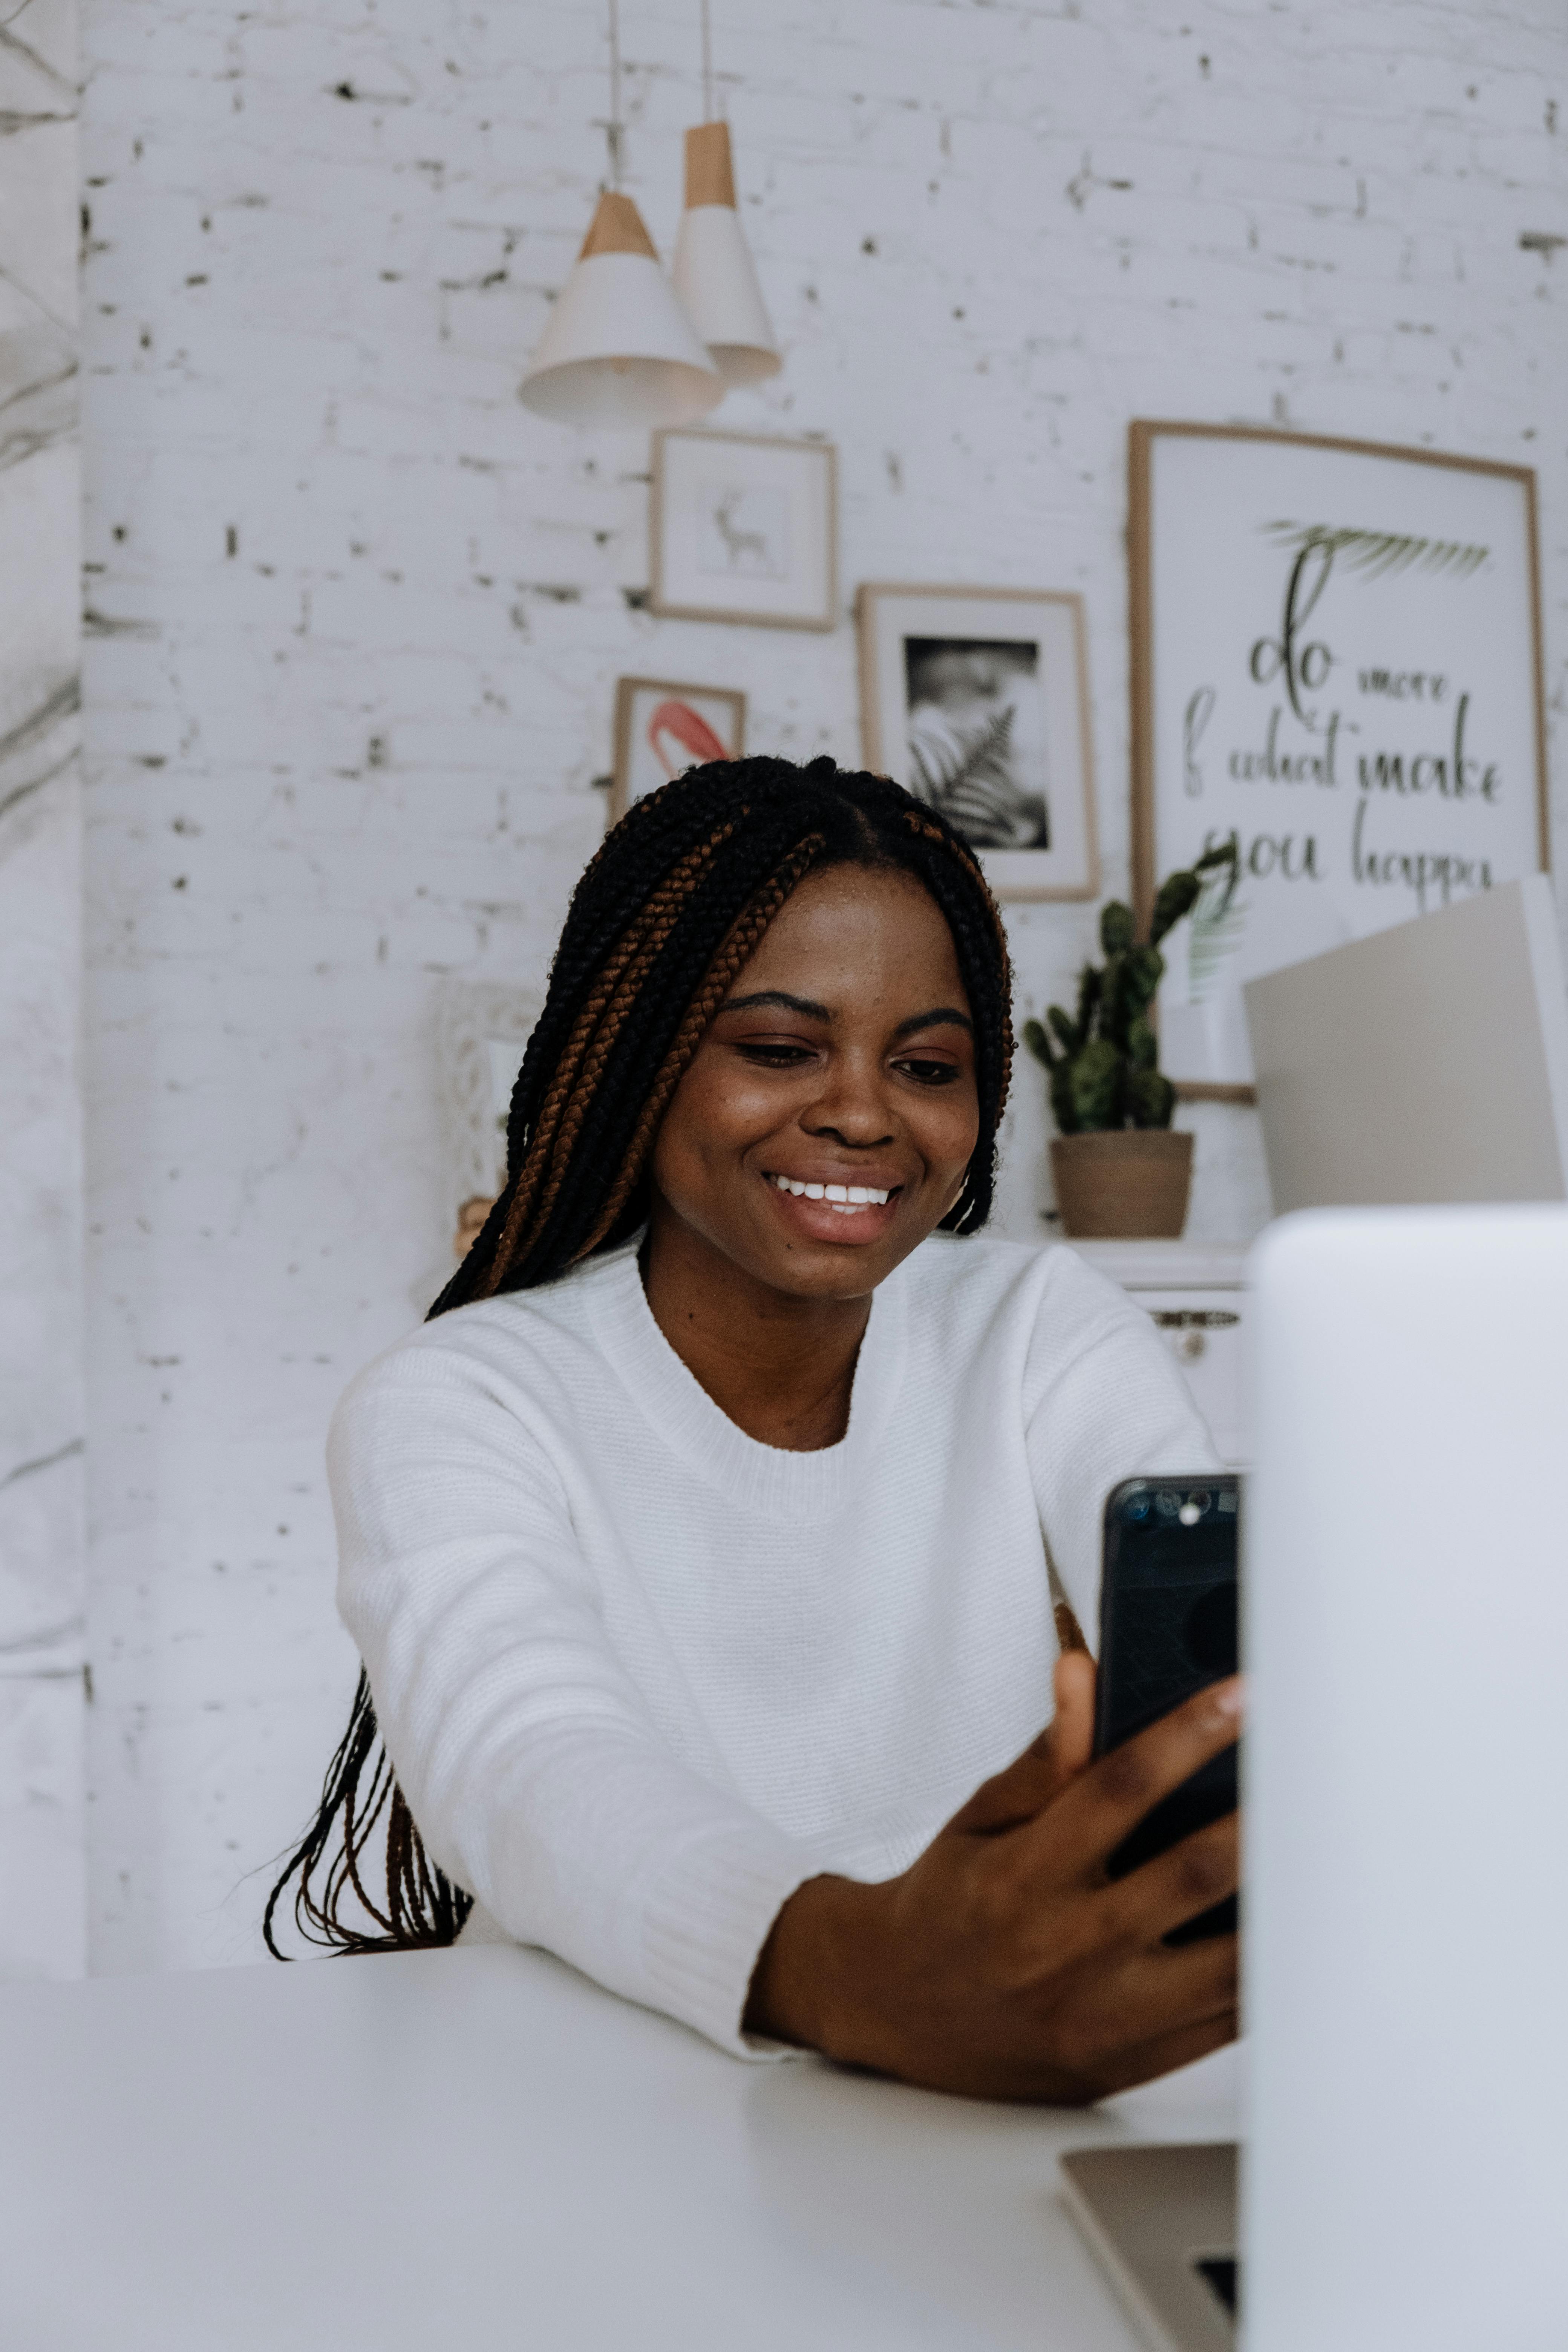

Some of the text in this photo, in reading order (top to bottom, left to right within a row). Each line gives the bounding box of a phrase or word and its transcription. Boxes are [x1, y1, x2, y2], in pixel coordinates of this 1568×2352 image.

[1248, 540, 1448, 733] do more
[1229, 704, 1340, 789] what
